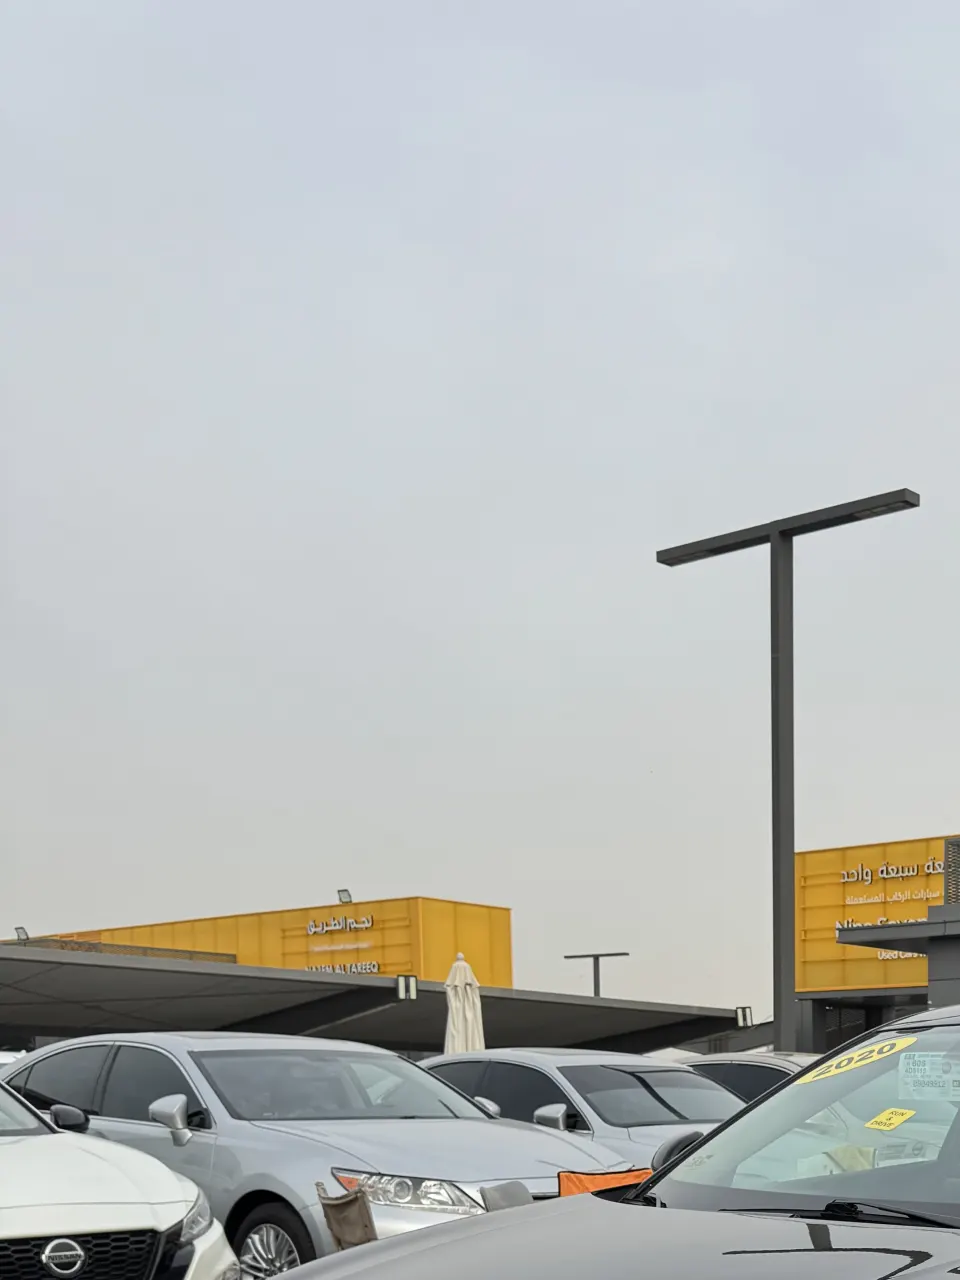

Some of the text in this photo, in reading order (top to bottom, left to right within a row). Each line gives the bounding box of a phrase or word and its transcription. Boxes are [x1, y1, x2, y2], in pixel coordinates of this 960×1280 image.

[840, 864, 873, 885] واحد
[878, 862, 918, 881] سبعة
[347, 961, 380, 974] TAREEQ
[811, 1042, 897, 1079] 2020
[870, 1120, 895, 1128] DRIVE
